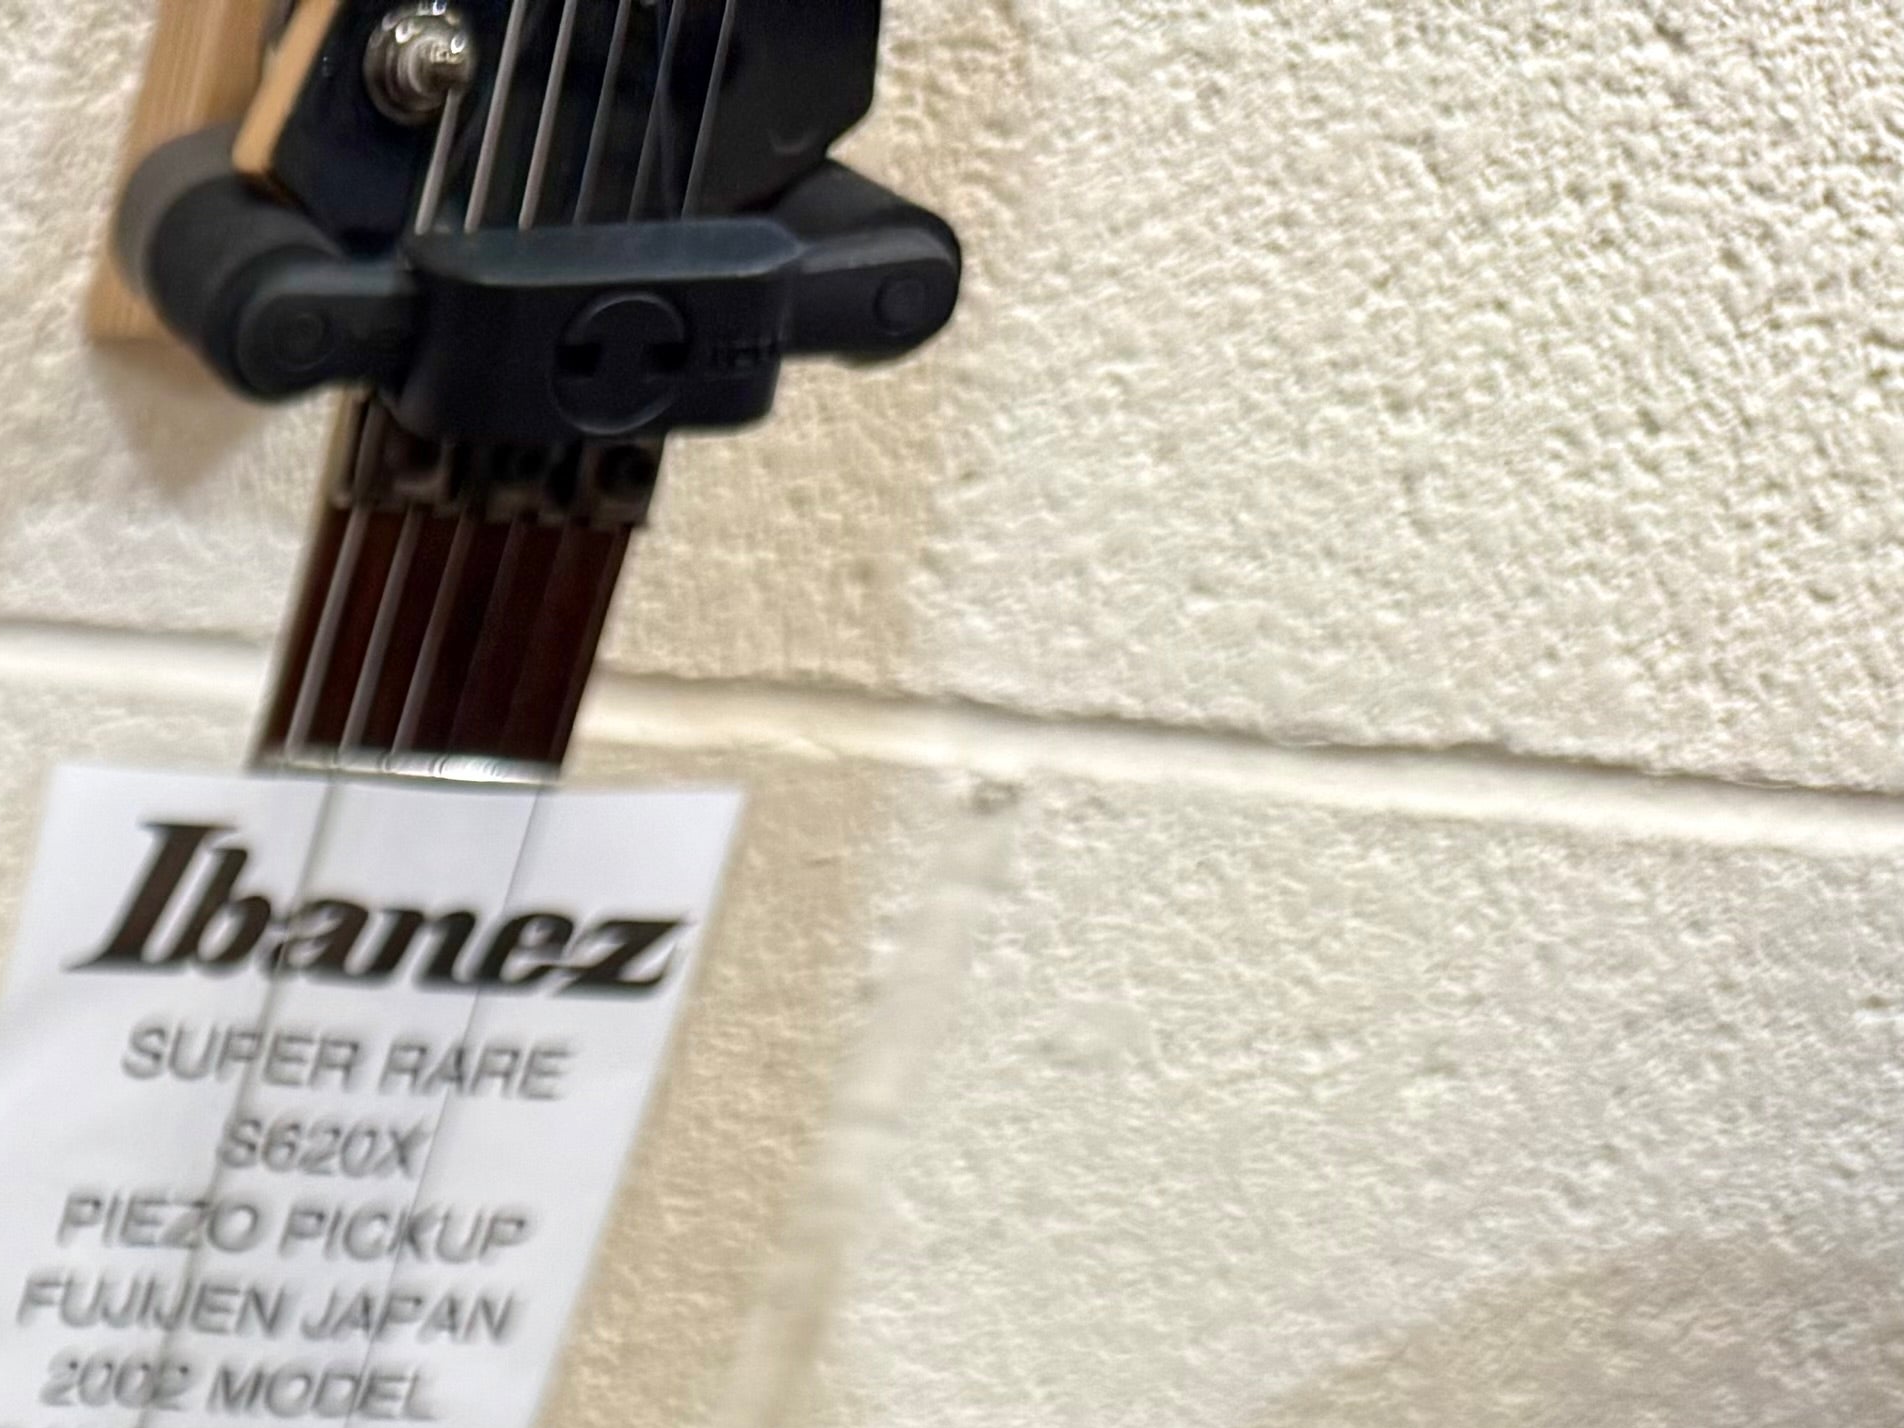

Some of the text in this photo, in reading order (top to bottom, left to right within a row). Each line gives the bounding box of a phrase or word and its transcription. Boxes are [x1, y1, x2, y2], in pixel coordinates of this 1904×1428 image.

[62, 821, 696, 1001] Ibanez
[121, 1021, 576, 1102] SUPER RARE
[217, 1114, 434, 1179] S620X
[56, 1190, 535, 1265] PIEZO PICKUP
[299, 1285, 520, 1345] JAPAN
[39, 1346, 441, 1420] 2002 MODEL
